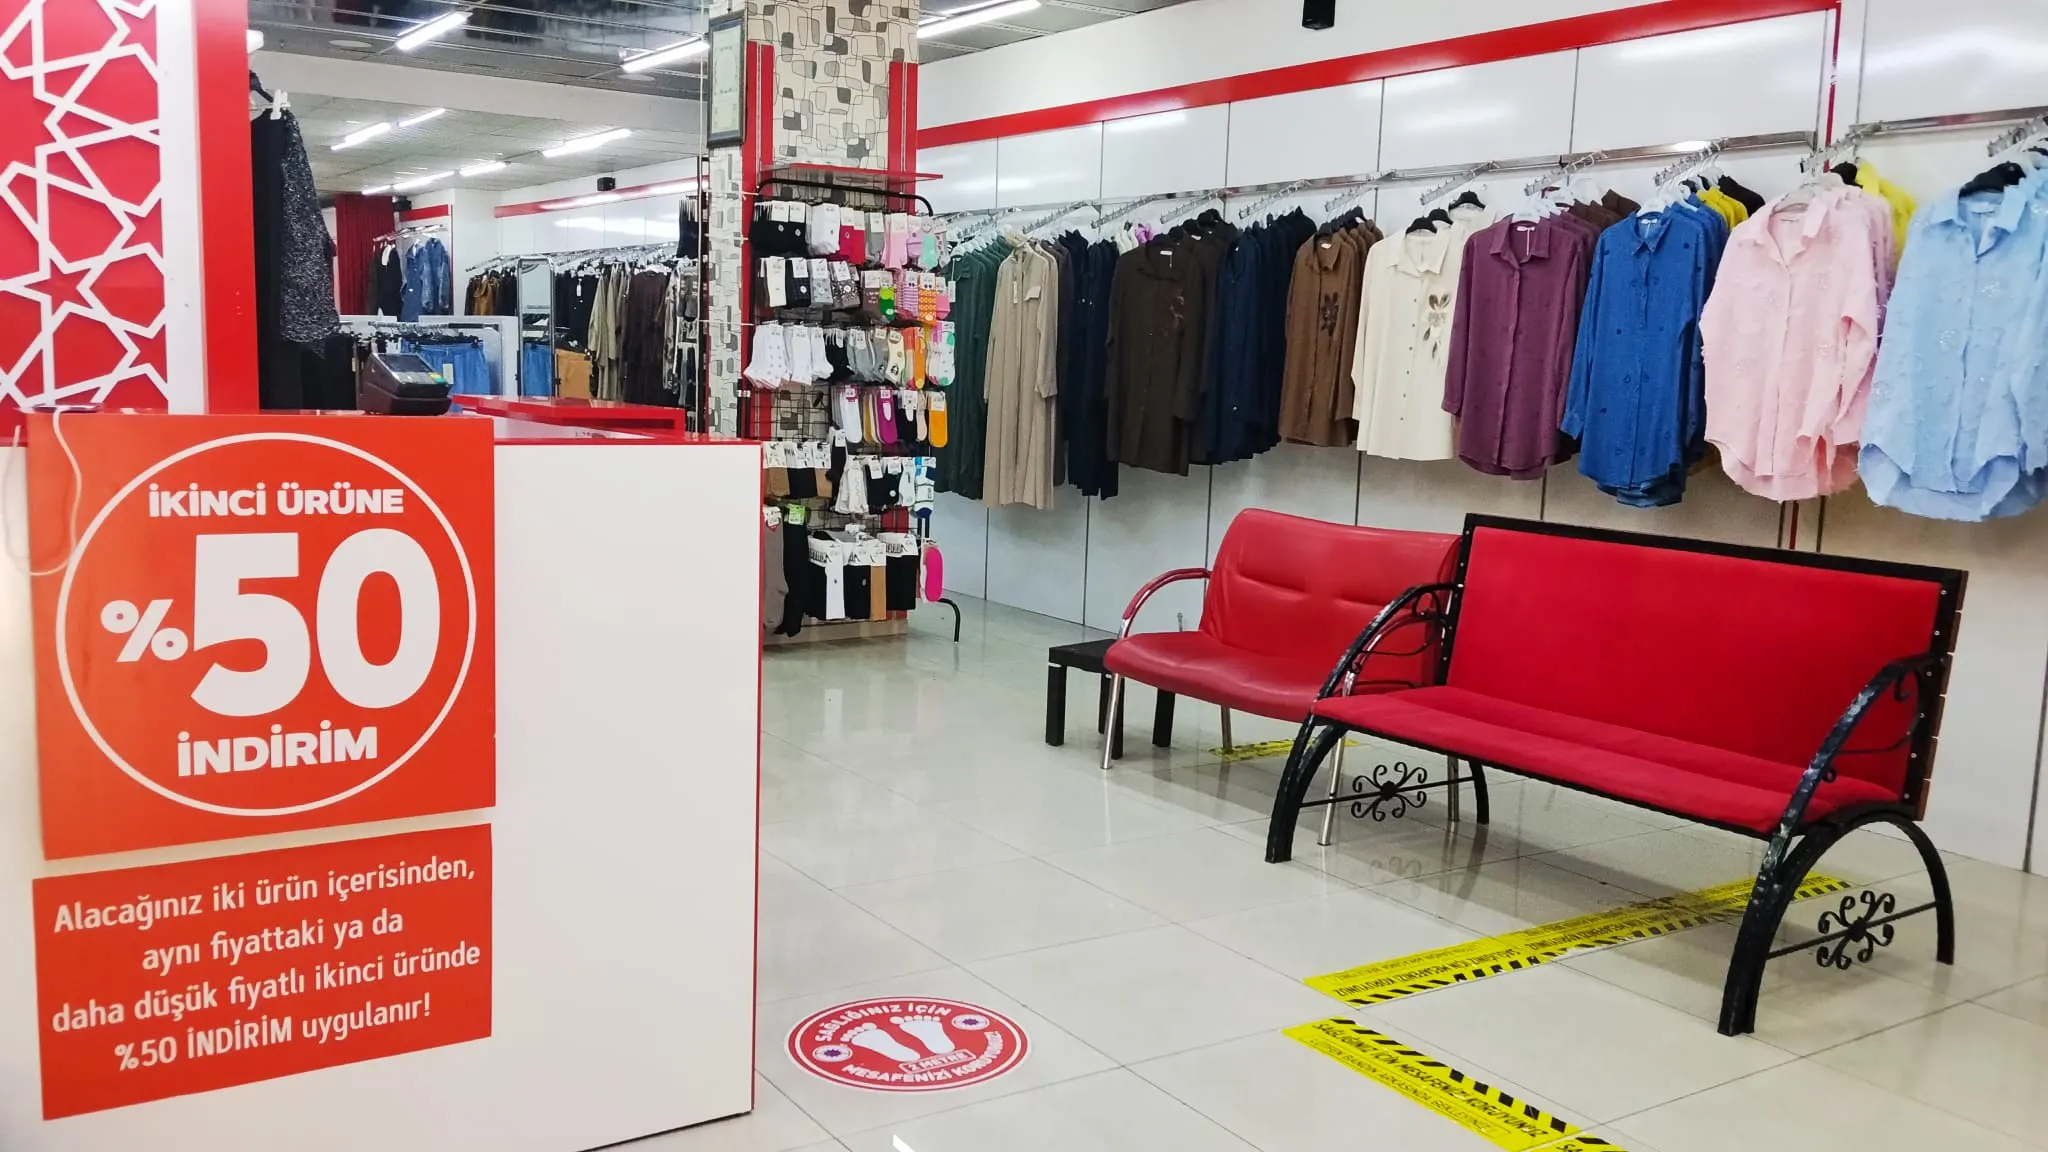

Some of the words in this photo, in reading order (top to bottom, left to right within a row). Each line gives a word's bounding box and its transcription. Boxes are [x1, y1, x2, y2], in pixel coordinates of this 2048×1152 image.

[149, 482, 266, 518] İKİNCİ
[277, 481, 405, 516] ÜRÜNE
[101, 528, 440, 717] %50
[177, 720, 378, 777] İNDİRİM
[54, 892, 202, 933] Alacağınız
[213, 883, 245, 912] iki
[256, 873, 318, 905] ürün
[328, 855, 476, 903] içerisinden,
[141, 944, 200, 975] aynı
[210, 918, 324, 968] fiyattaki
[333, 920, 363, 950] ya
[372, 909, 404, 935] da
[52, 1000, 125, 1032] daha
[134, 982, 219, 1022] düşük
[227, 967, 305, 1010] fiyatlı
[315, 955, 384, 993] ikinci
[393, 941, 481, 978] üründe
[908, 1002, 952, 1016] İÇİN
[113, 1038, 177, 1070] %50
[188, 1013, 293, 1058] İNDİRİM
[302, 993, 431, 1044] uygulanır!
